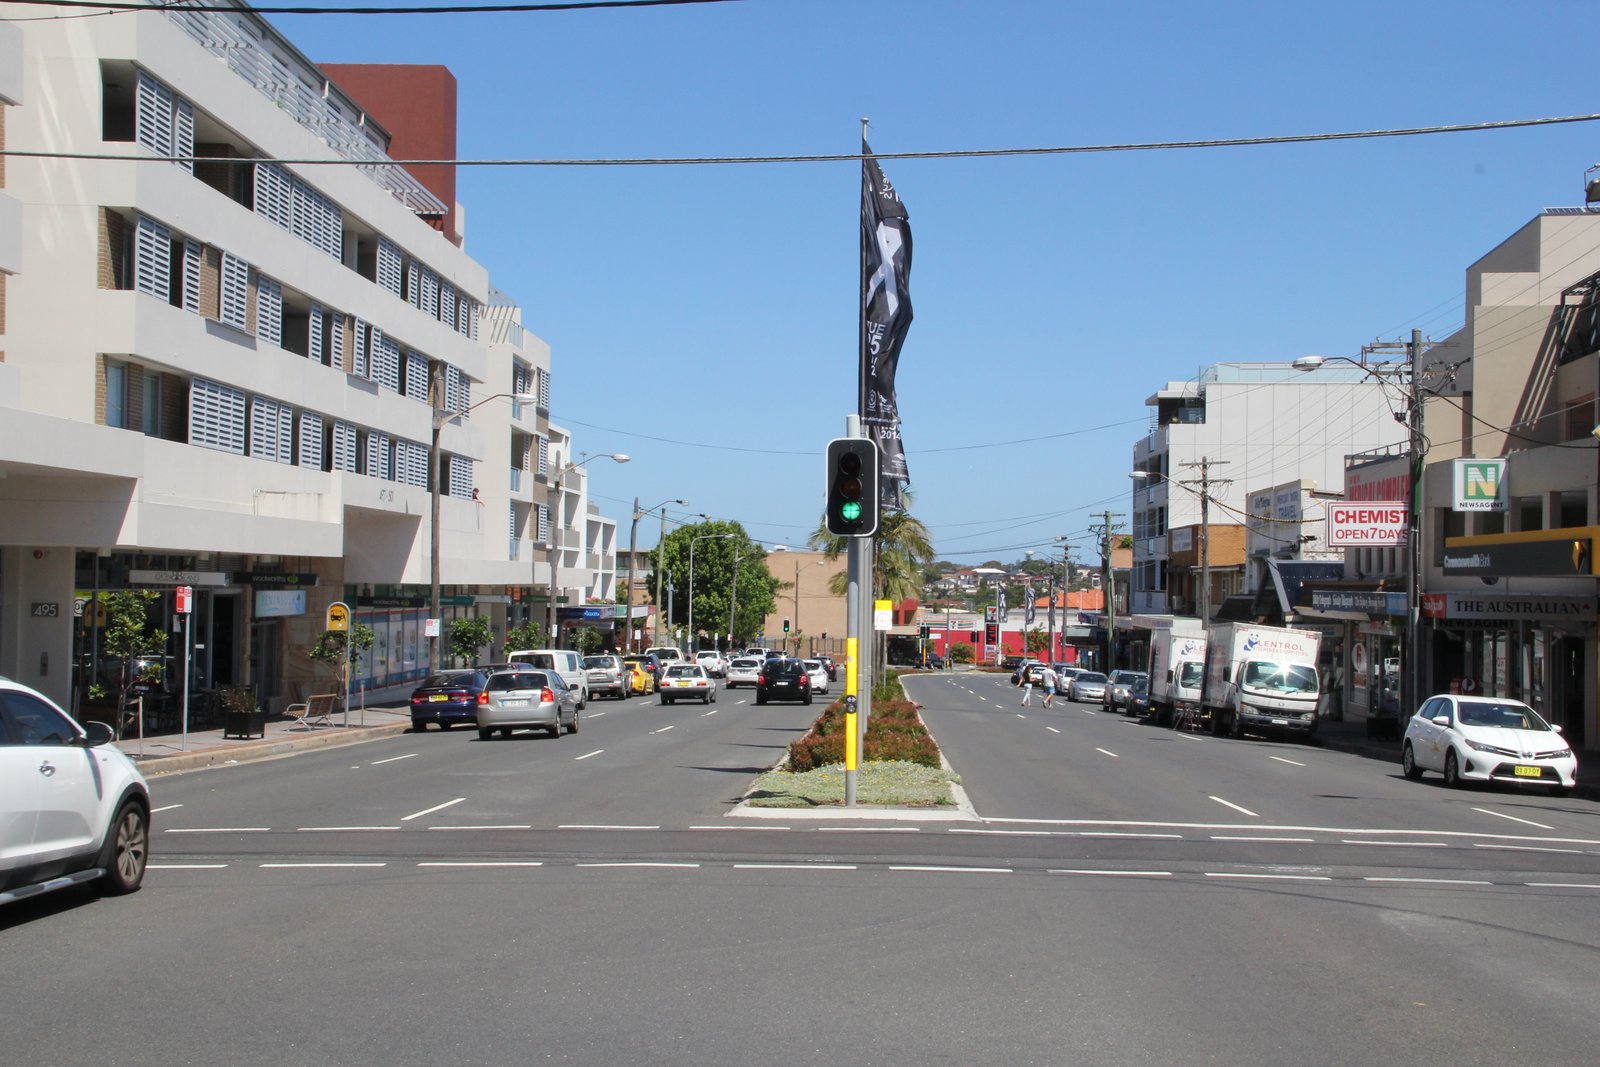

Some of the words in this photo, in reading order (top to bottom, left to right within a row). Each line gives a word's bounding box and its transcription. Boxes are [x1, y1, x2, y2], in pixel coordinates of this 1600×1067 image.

[1334, 510, 1409, 524] CHEMIST
[1335, 529, 1369, 539] OPEN
[1369, 527, 1378, 539] 7
[1378, 529, 1409, 539] DAYS
[34, 604, 57, 616] 495
[1454, 601, 1485, 612] THE
[1486, 601, 1581, 614] AUSTRALIAN
